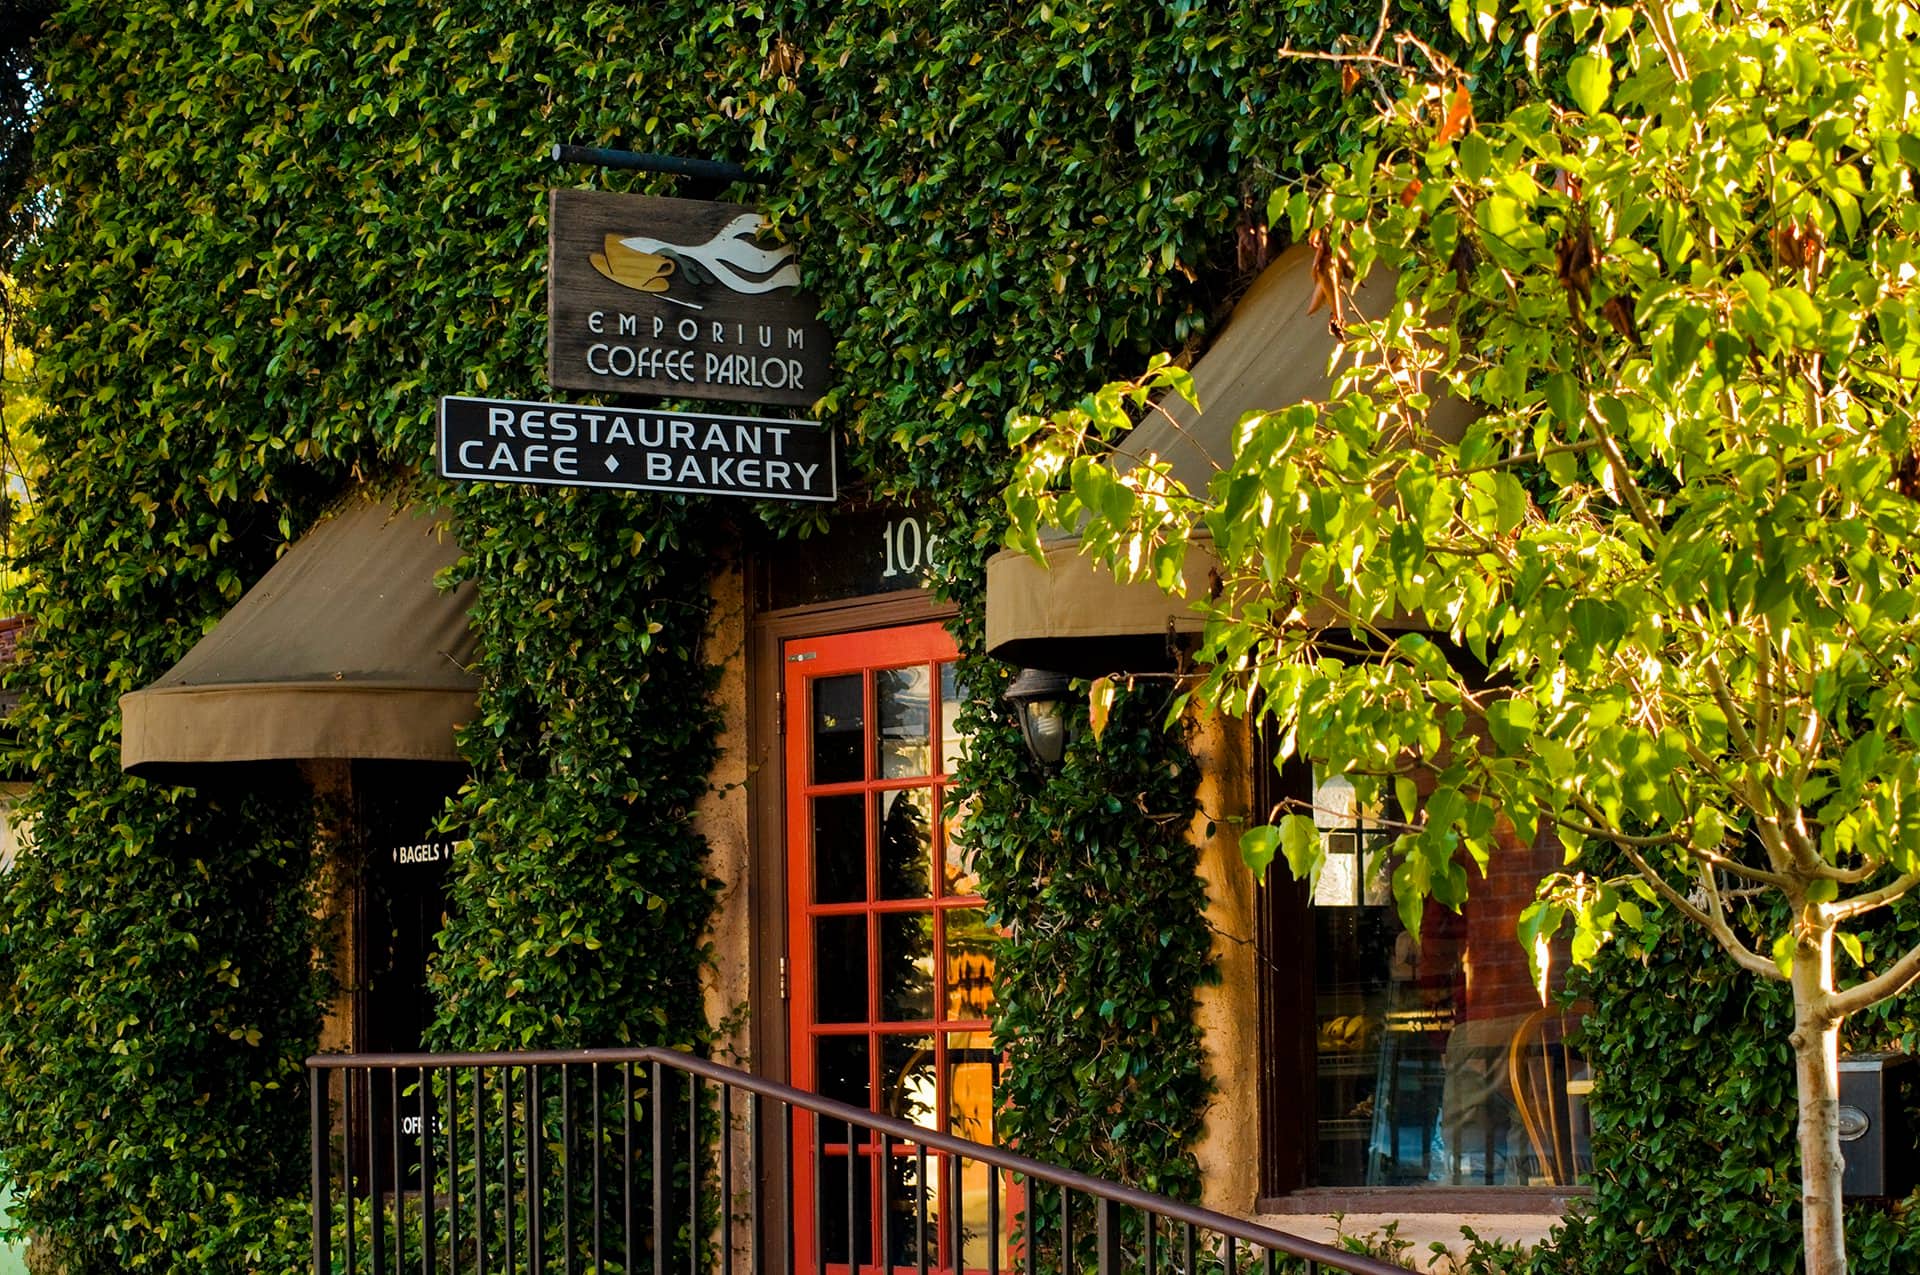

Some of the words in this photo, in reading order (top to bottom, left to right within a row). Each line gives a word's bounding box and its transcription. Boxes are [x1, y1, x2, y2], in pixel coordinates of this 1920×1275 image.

[587, 312, 804, 350] EMPORIUM
[586, 343, 696, 383] COFFEE
[705, 352, 804, 390] PARLOR
[488, 408, 791, 456] RESTAURANT
[458, 440, 579, 476] CAFE
[646, 453, 820, 491] BAKERY
[399, 843, 440, 864] BAGELS
